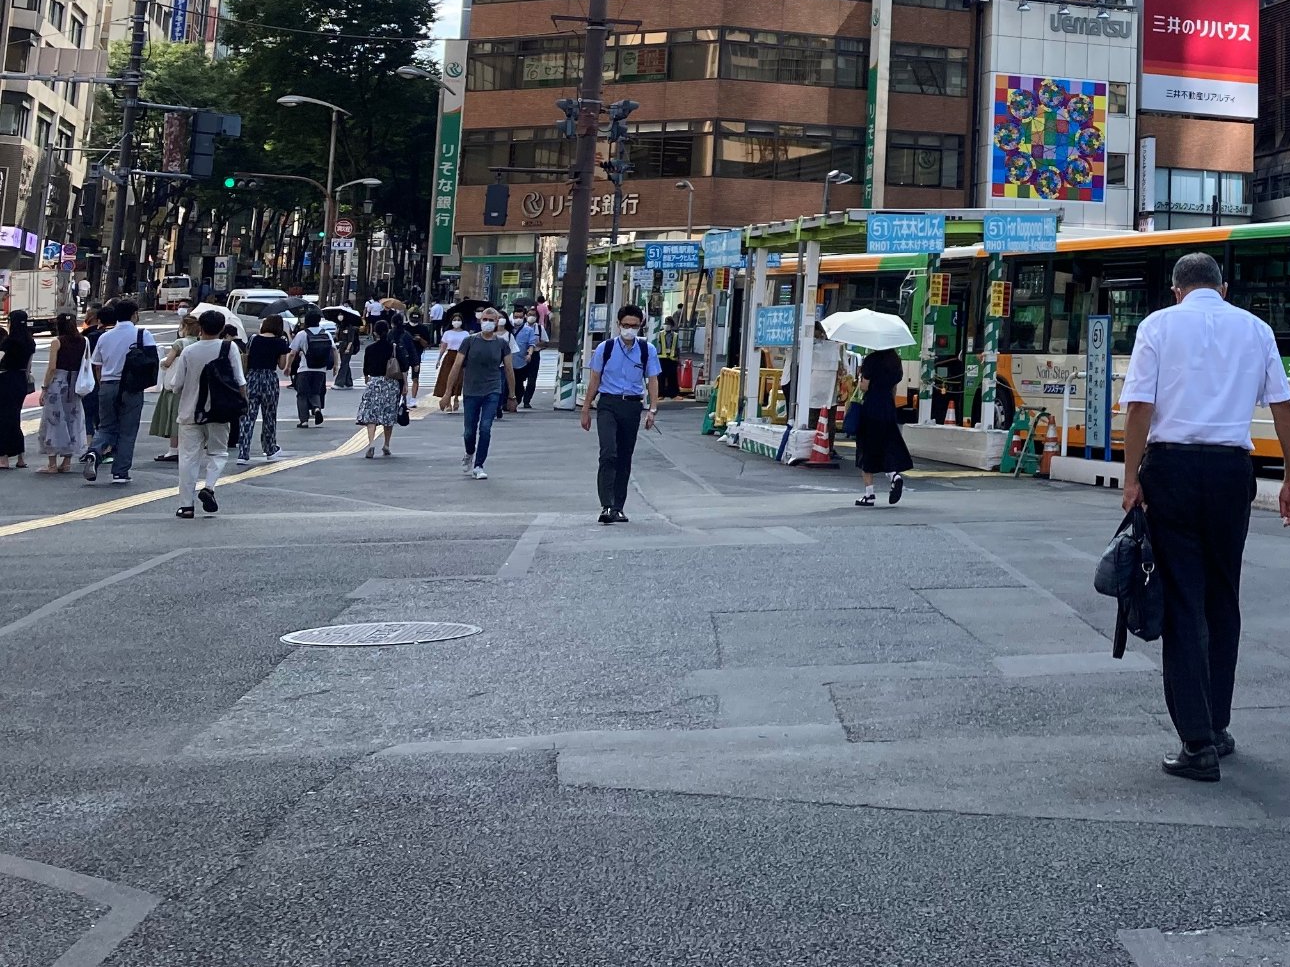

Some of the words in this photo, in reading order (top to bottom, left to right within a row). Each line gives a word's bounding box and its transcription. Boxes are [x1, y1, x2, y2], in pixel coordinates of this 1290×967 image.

[1152, 14, 1252, 42] 三井のリハウス
[1165, 88, 1236, 104] 三井不動産リアルティ
[435, 143, 454, 227] りそな銀行
[549, 193, 639, 217] りな銀行
[873, 222, 888, 236] 51
[989, 222, 1004, 236] 51
[869, 240, 890, 251] RH01
[892, 239, 943, 251] 六本木けやき坂
[986, 240, 1005, 250] RH01
[650, 248, 660, 258] 51
[767, 310, 795, 325] 六本木ヒル
[1093, 328, 1102, 342] 51
